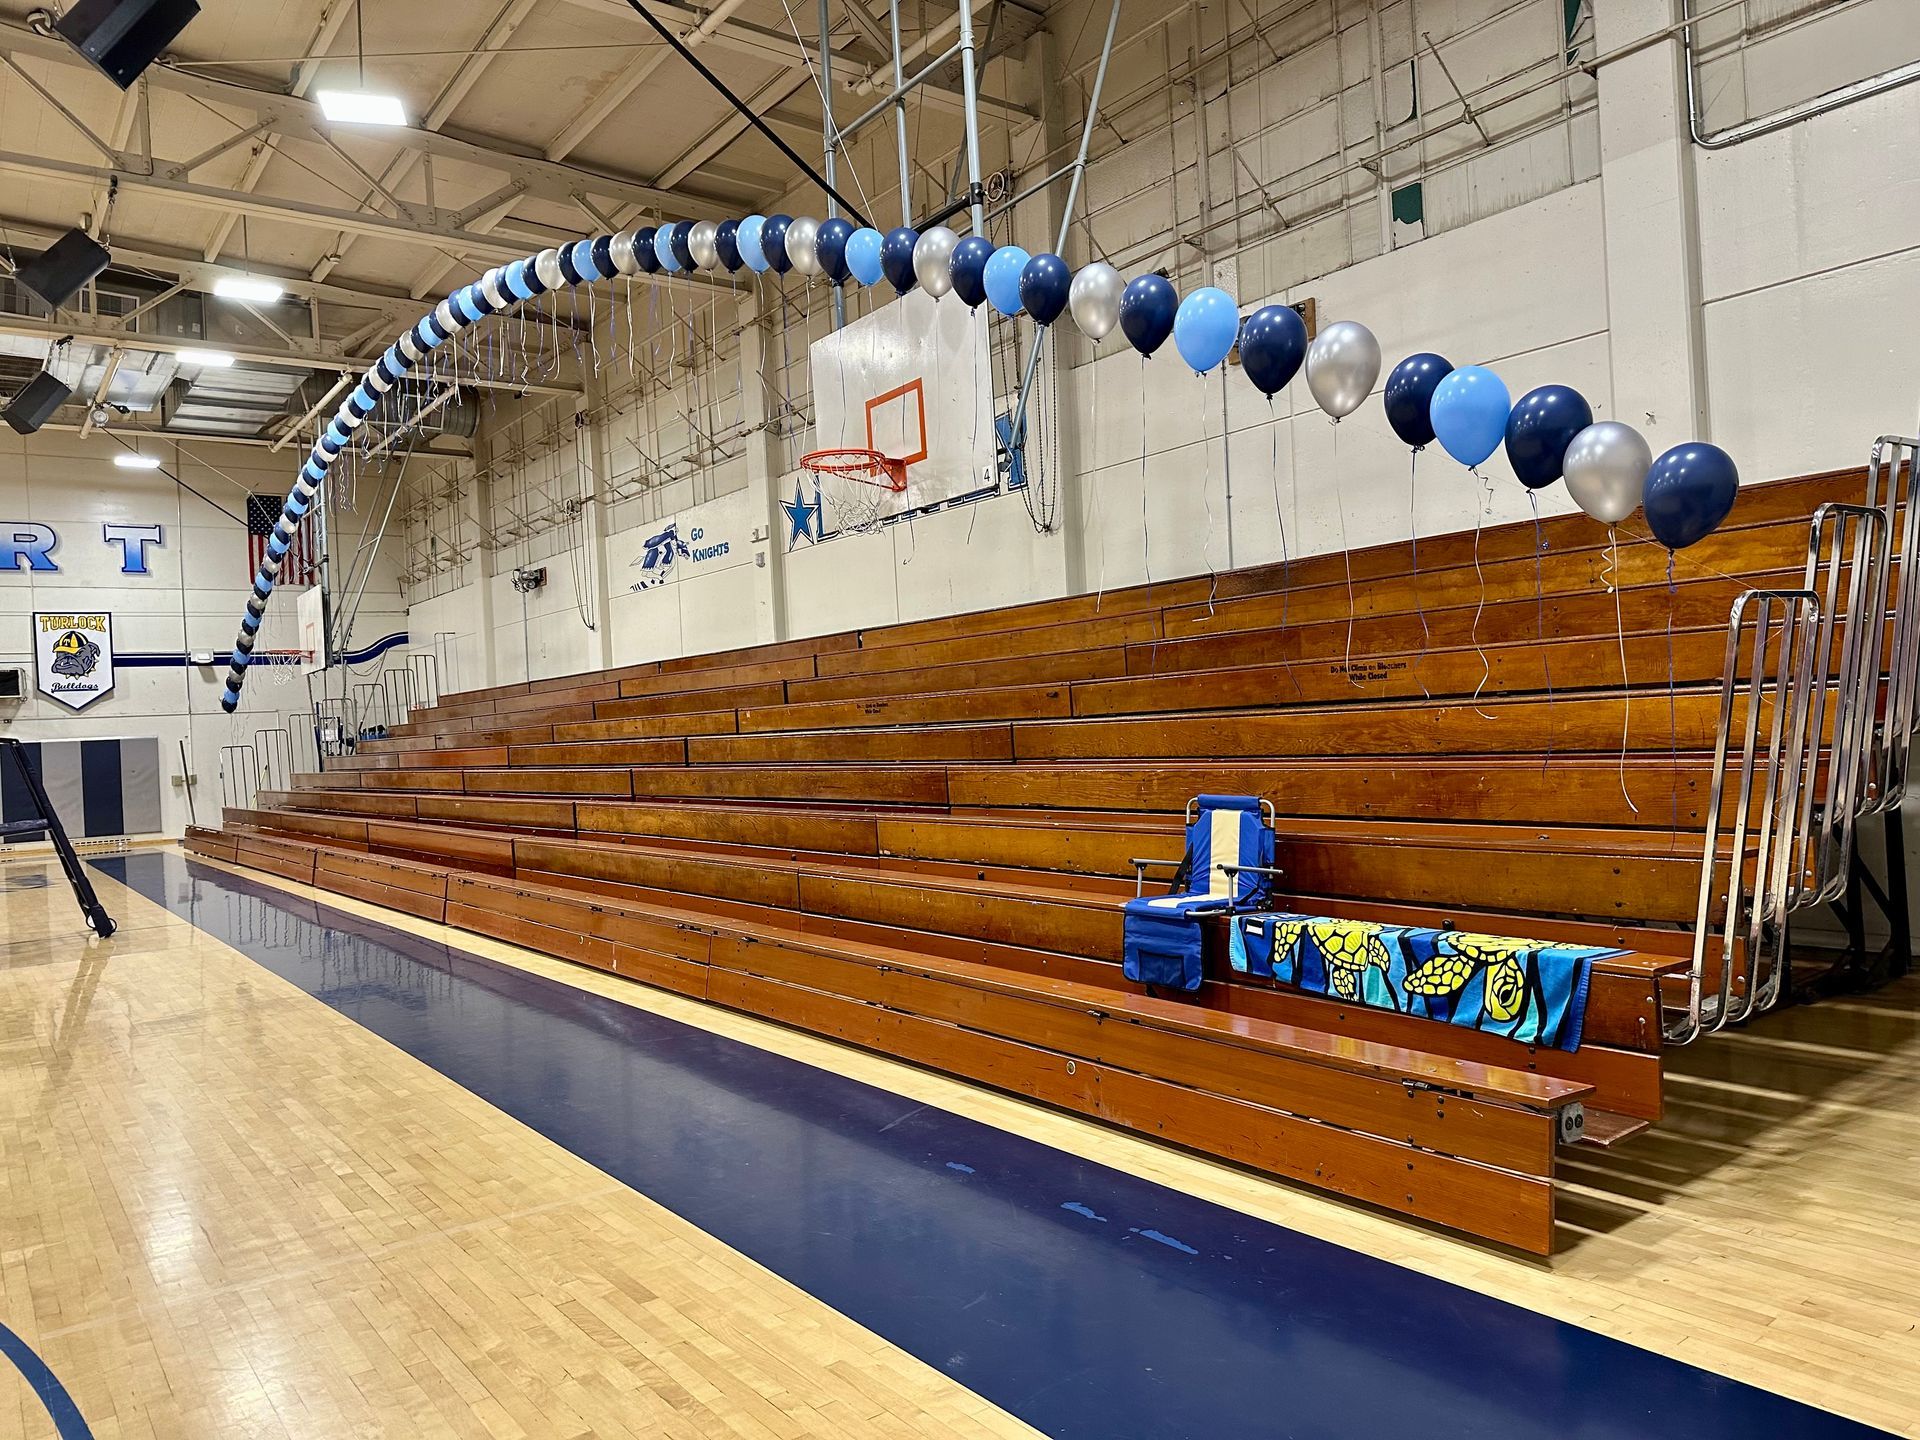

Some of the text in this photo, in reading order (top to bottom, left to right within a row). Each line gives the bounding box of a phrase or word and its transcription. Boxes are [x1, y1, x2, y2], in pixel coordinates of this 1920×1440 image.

[984, 468, 991, 482] 4
[690, 527, 704, 542] GO
[692, 542, 730, 563] KNIGHTS
[40, 615, 107, 633] TURLOCK
[1330, 665, 1339, 674] Do
[1349, 671, 1388, 681] While Closed
[51, 682, 99, 691] Bulldogs
